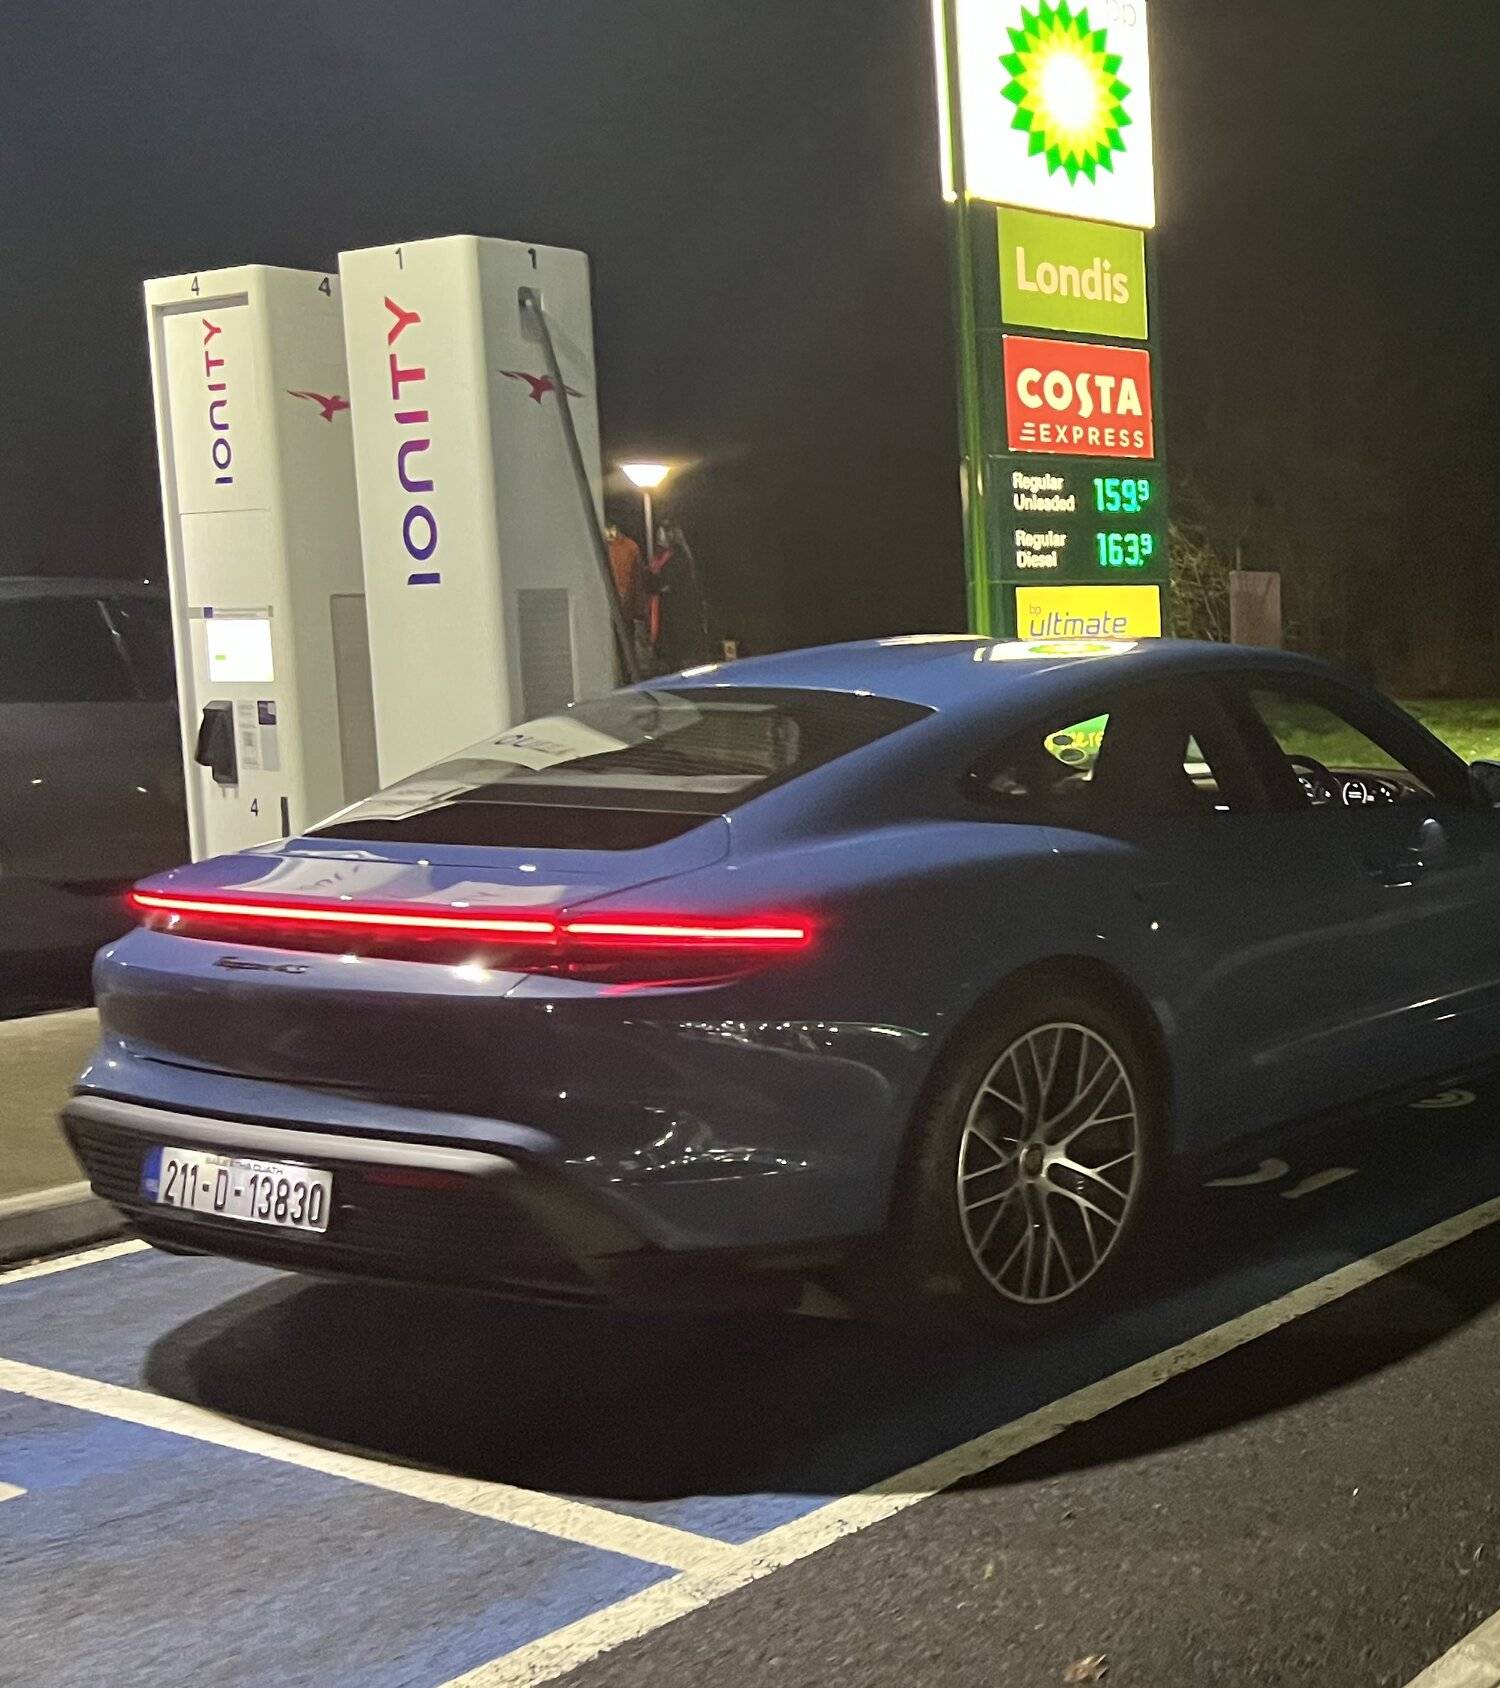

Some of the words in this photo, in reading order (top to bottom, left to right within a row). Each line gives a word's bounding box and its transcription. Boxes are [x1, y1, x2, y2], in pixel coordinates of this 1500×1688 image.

[394, 248, 403, 270] 1
[527, 248, 537, 270] 1
[190, 276, 200, 296] 4
[1016, 246, 1129, 304] Londis
[318, 277, 331, 297] 4
[202, 318, 233, 484] IONITY
[1016, 367, 1143, 419] COSTA
[384, 296, 441, 585] IONITY
[1039, 423, 1144, 449] EXPRESS
[1012, 471, 1064, 493] Regular
[1013, 493, 1075, 512] Unleaded
[1015, 529, 1067, 550] Regular
[1016, 551, 1058, 568] Diesel
[1029, 604, 1041, 616] bp
[1030, 611, 1128, 637] ultimate
[250, 798, 259, 816] 4
[165, 1160, 323, 1227] 211-D-13830
